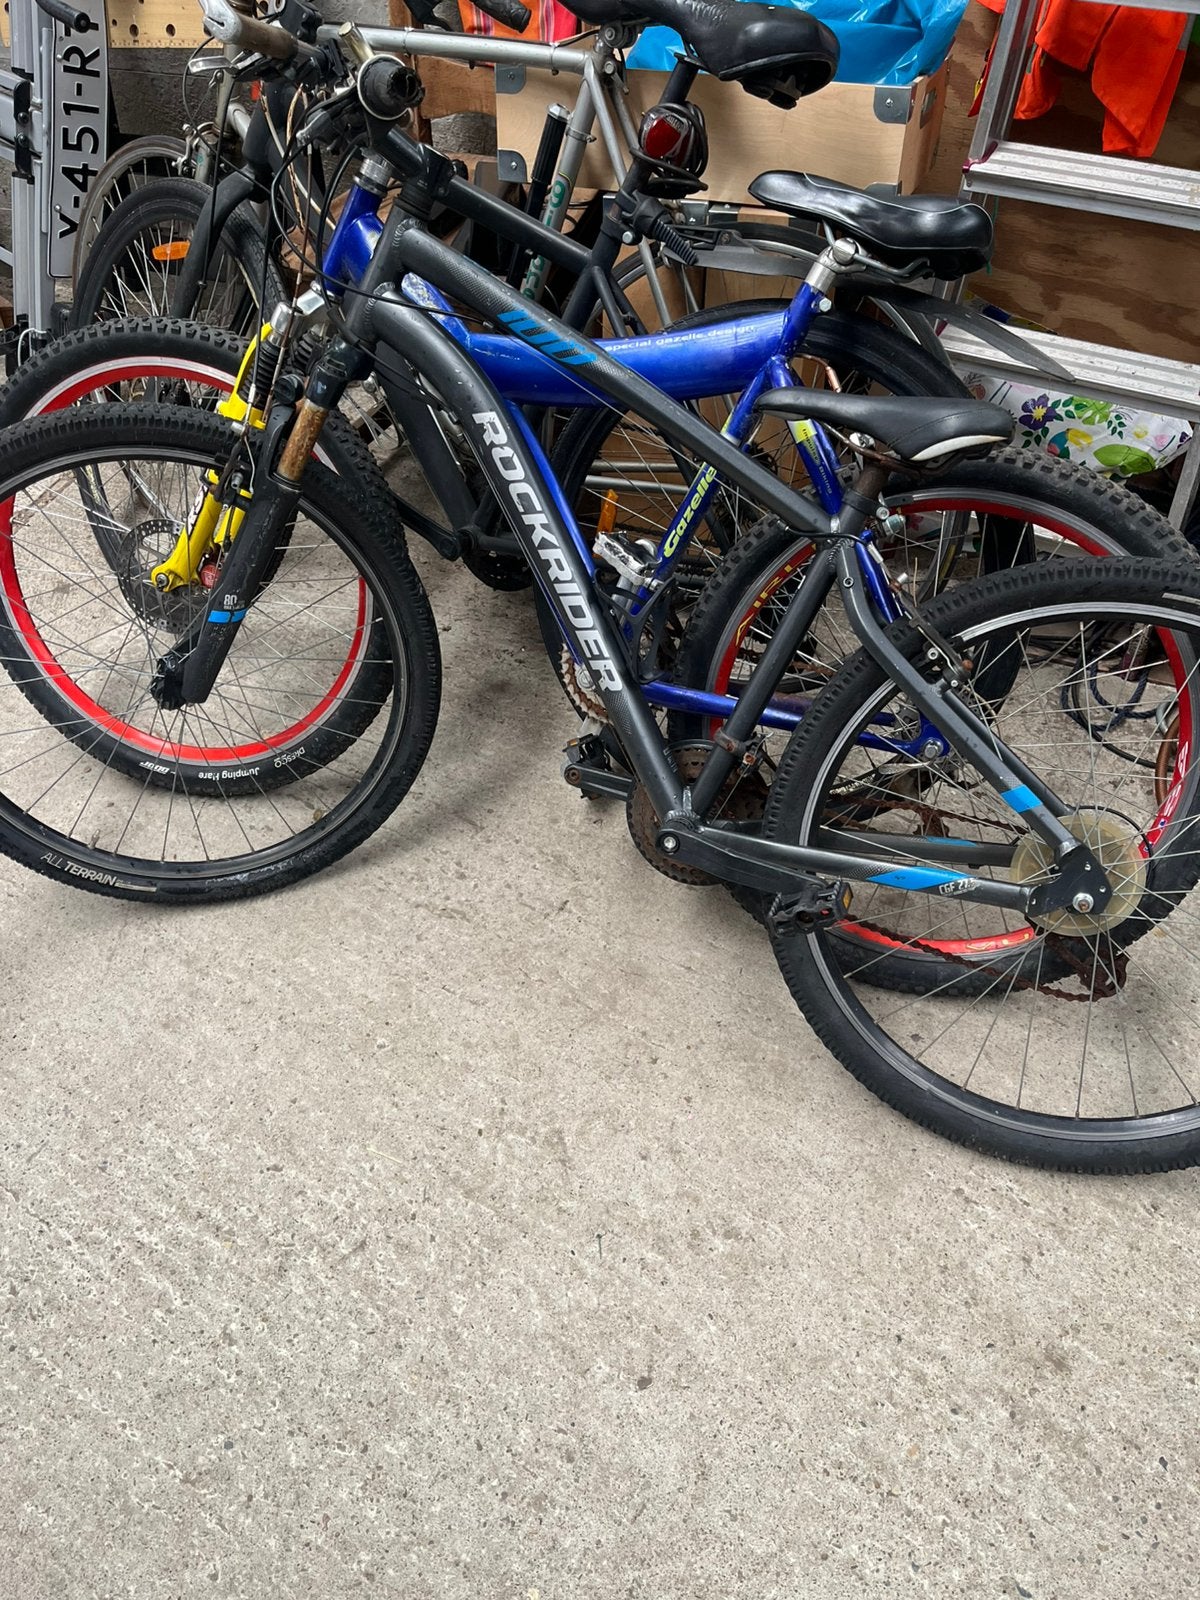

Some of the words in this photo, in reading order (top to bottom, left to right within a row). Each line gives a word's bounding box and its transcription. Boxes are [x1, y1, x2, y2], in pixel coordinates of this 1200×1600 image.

[522, 180, 566, 300] giane
[655, 332, 704, 346] gazelle
[663, 466, 718, 558] Gazelle
[472, 411, 623, 692] ROCKRIDER
[198, 770, 220, 782] Hare
[221, 766, 261, 780] Jumping
[40, 852, 62, 869] ALL
[63, 861, 118, 887] TERRAIN
